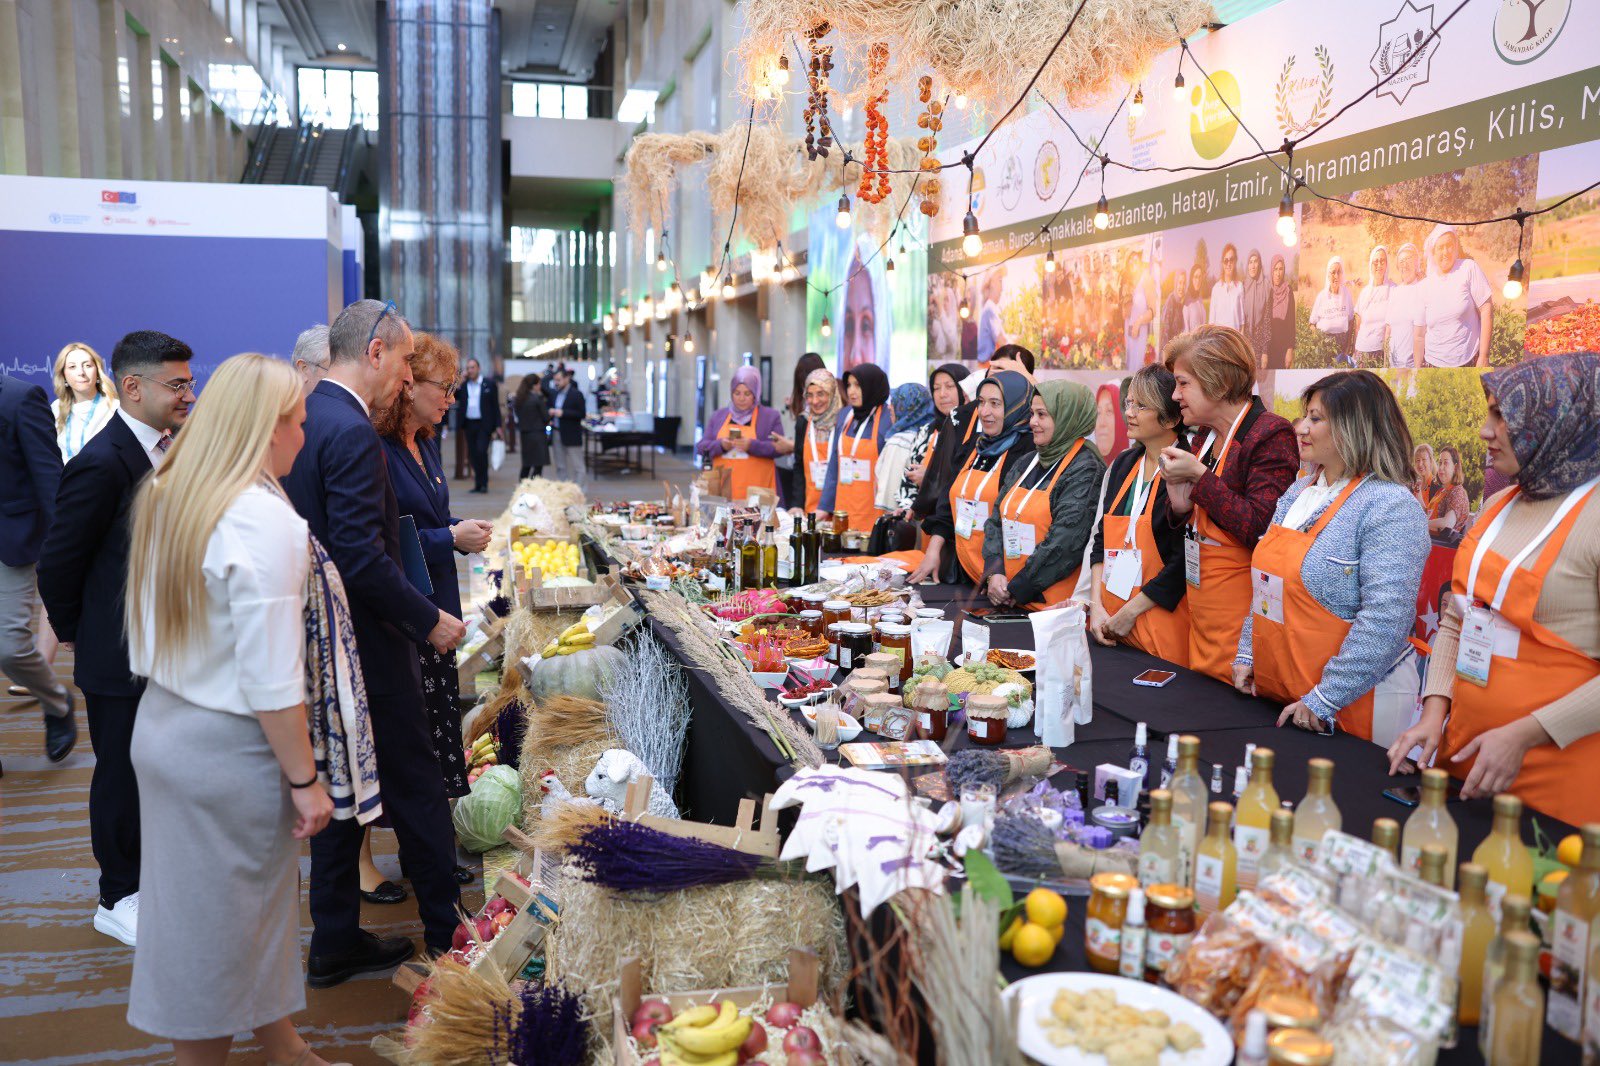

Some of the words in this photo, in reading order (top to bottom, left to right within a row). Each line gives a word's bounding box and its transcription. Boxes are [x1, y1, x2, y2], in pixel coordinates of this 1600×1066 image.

[1535, 27, 1553, 47] KOOP
[1387, 72, 1418, 86] NAZENDE
[1009, 231, 1037, 250] Bursa,
[1107, 202, 1166, 229] aziantep,
[1172, 188, 1218, 216] Hatay,
[1225, 171, 1272, 204] İzmir,
[1280, 125, 1475, 191] Kahramanmaraş,
[1488, 99, 1564, 142] Kilis,
